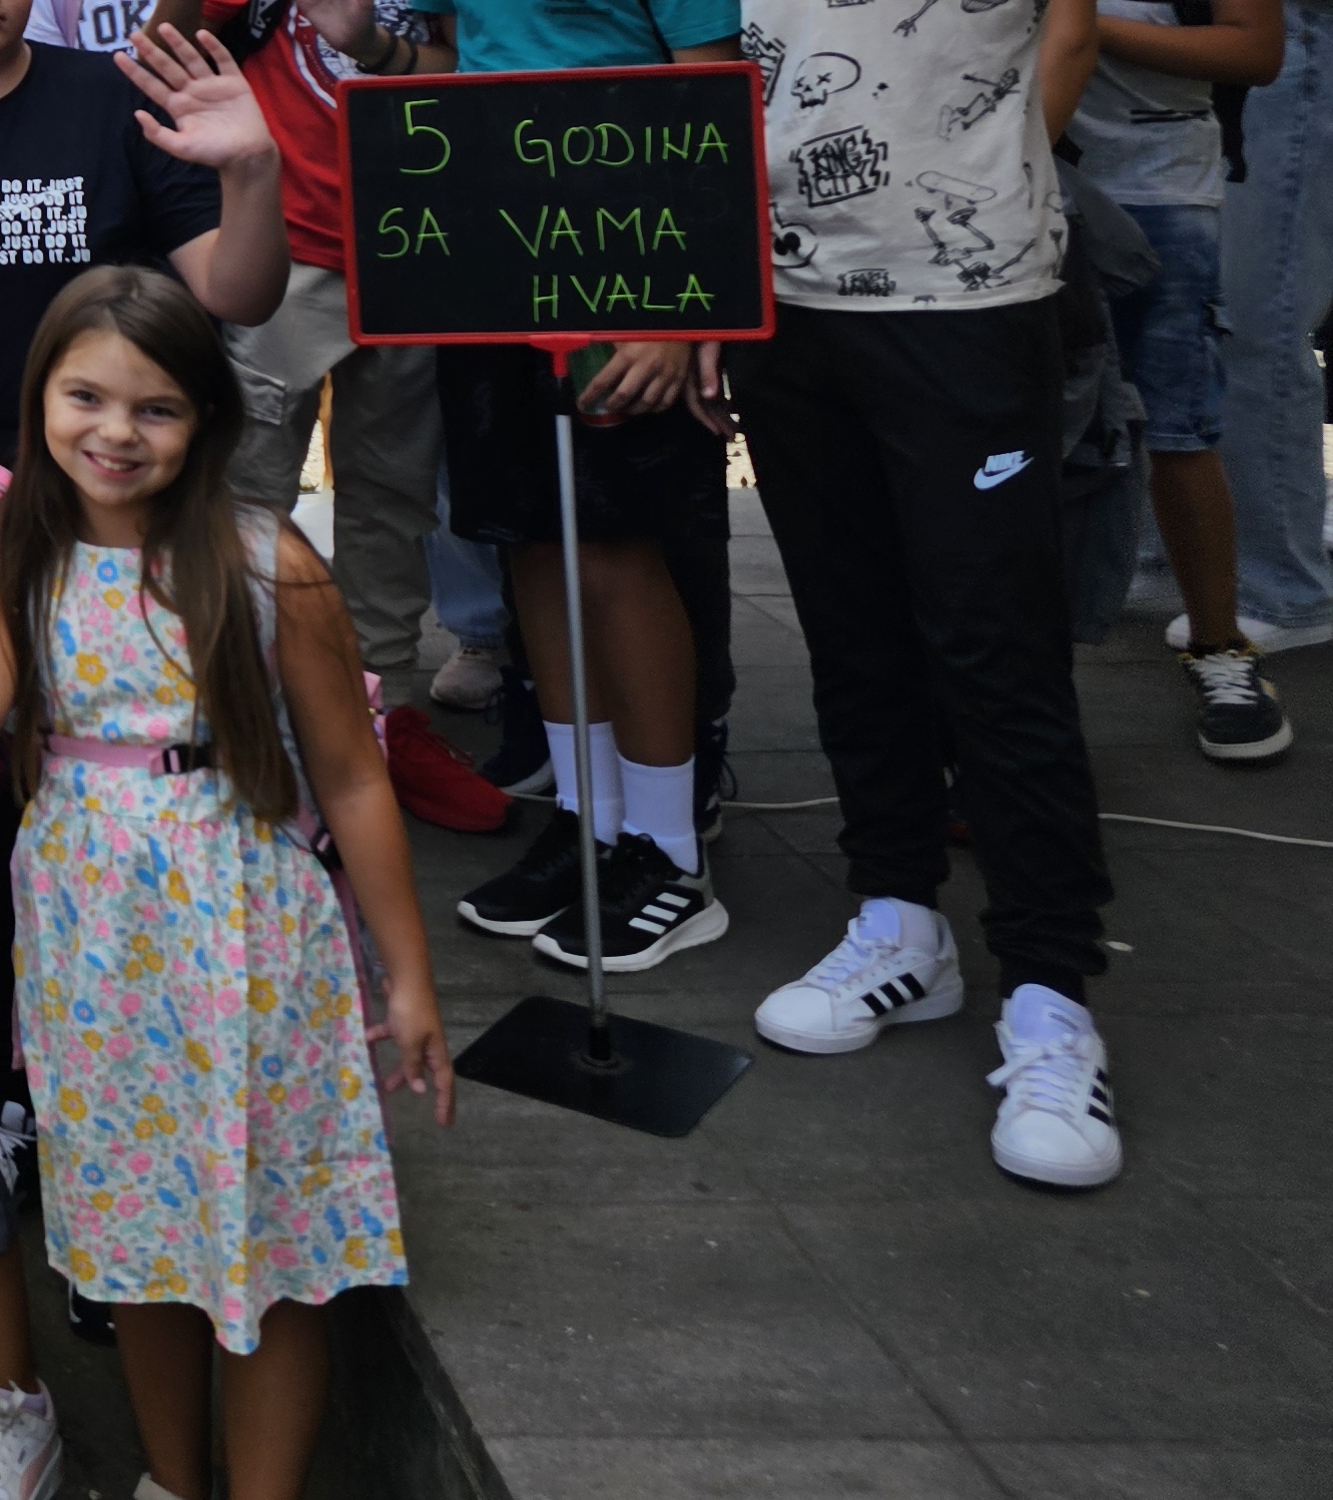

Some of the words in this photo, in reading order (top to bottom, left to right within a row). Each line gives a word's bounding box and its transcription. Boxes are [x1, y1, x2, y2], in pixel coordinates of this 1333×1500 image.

[399, 98, 452, 176] 5
[513, 118, 730, 179] GODINA
[1, 179, 22, 193] DO
[69, 192, 84, 205] IT
[1, 221, 22, 235] DO
[375, 206, 451, 259] SA
[497, 203, 688, 259] VAMA
[45, 234, 66, 249] DO
[71, 234, 86, 248] IT
[23, 249, 44, 264] DO
[532, 272, 716, 324] HVALA
